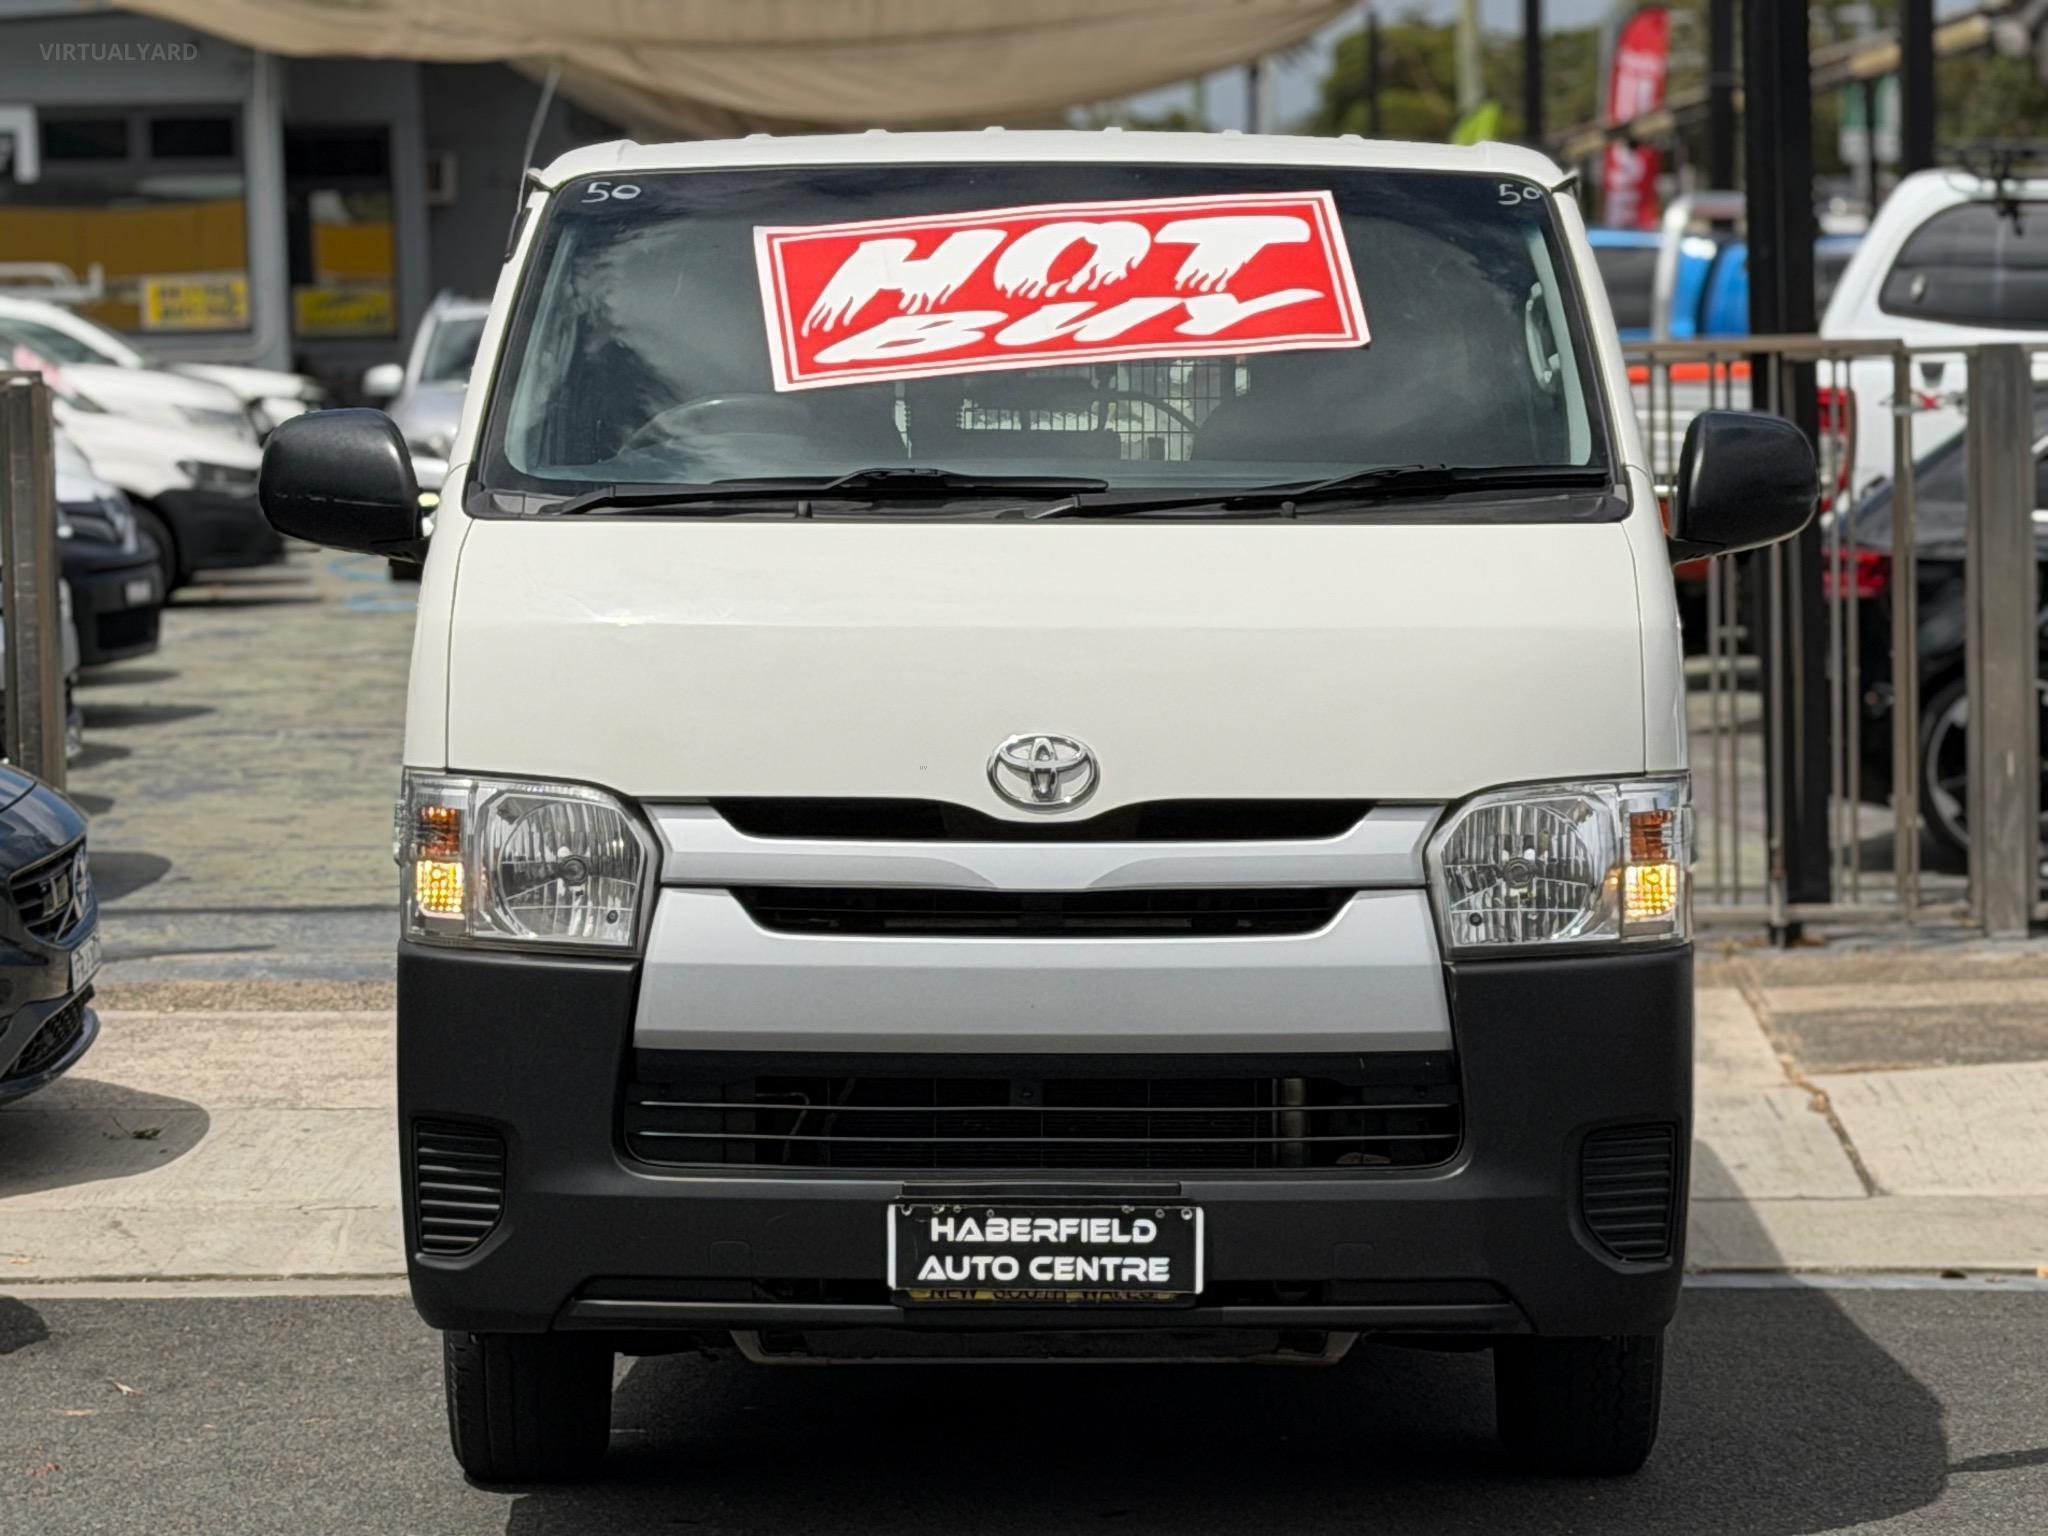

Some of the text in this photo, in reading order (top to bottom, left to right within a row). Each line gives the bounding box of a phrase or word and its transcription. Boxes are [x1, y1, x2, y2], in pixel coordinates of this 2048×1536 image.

[581, 181, 641, 203] 50
[1498, 183, 1541, 205] 50
[802, 215, 1310, 337] HOT
[813, 289, 1324, 364] BUY
[930, 1217, 1157, 1243] HABERFIELD
[917, 1255, 1170, 1282] AUTO CENTRE
